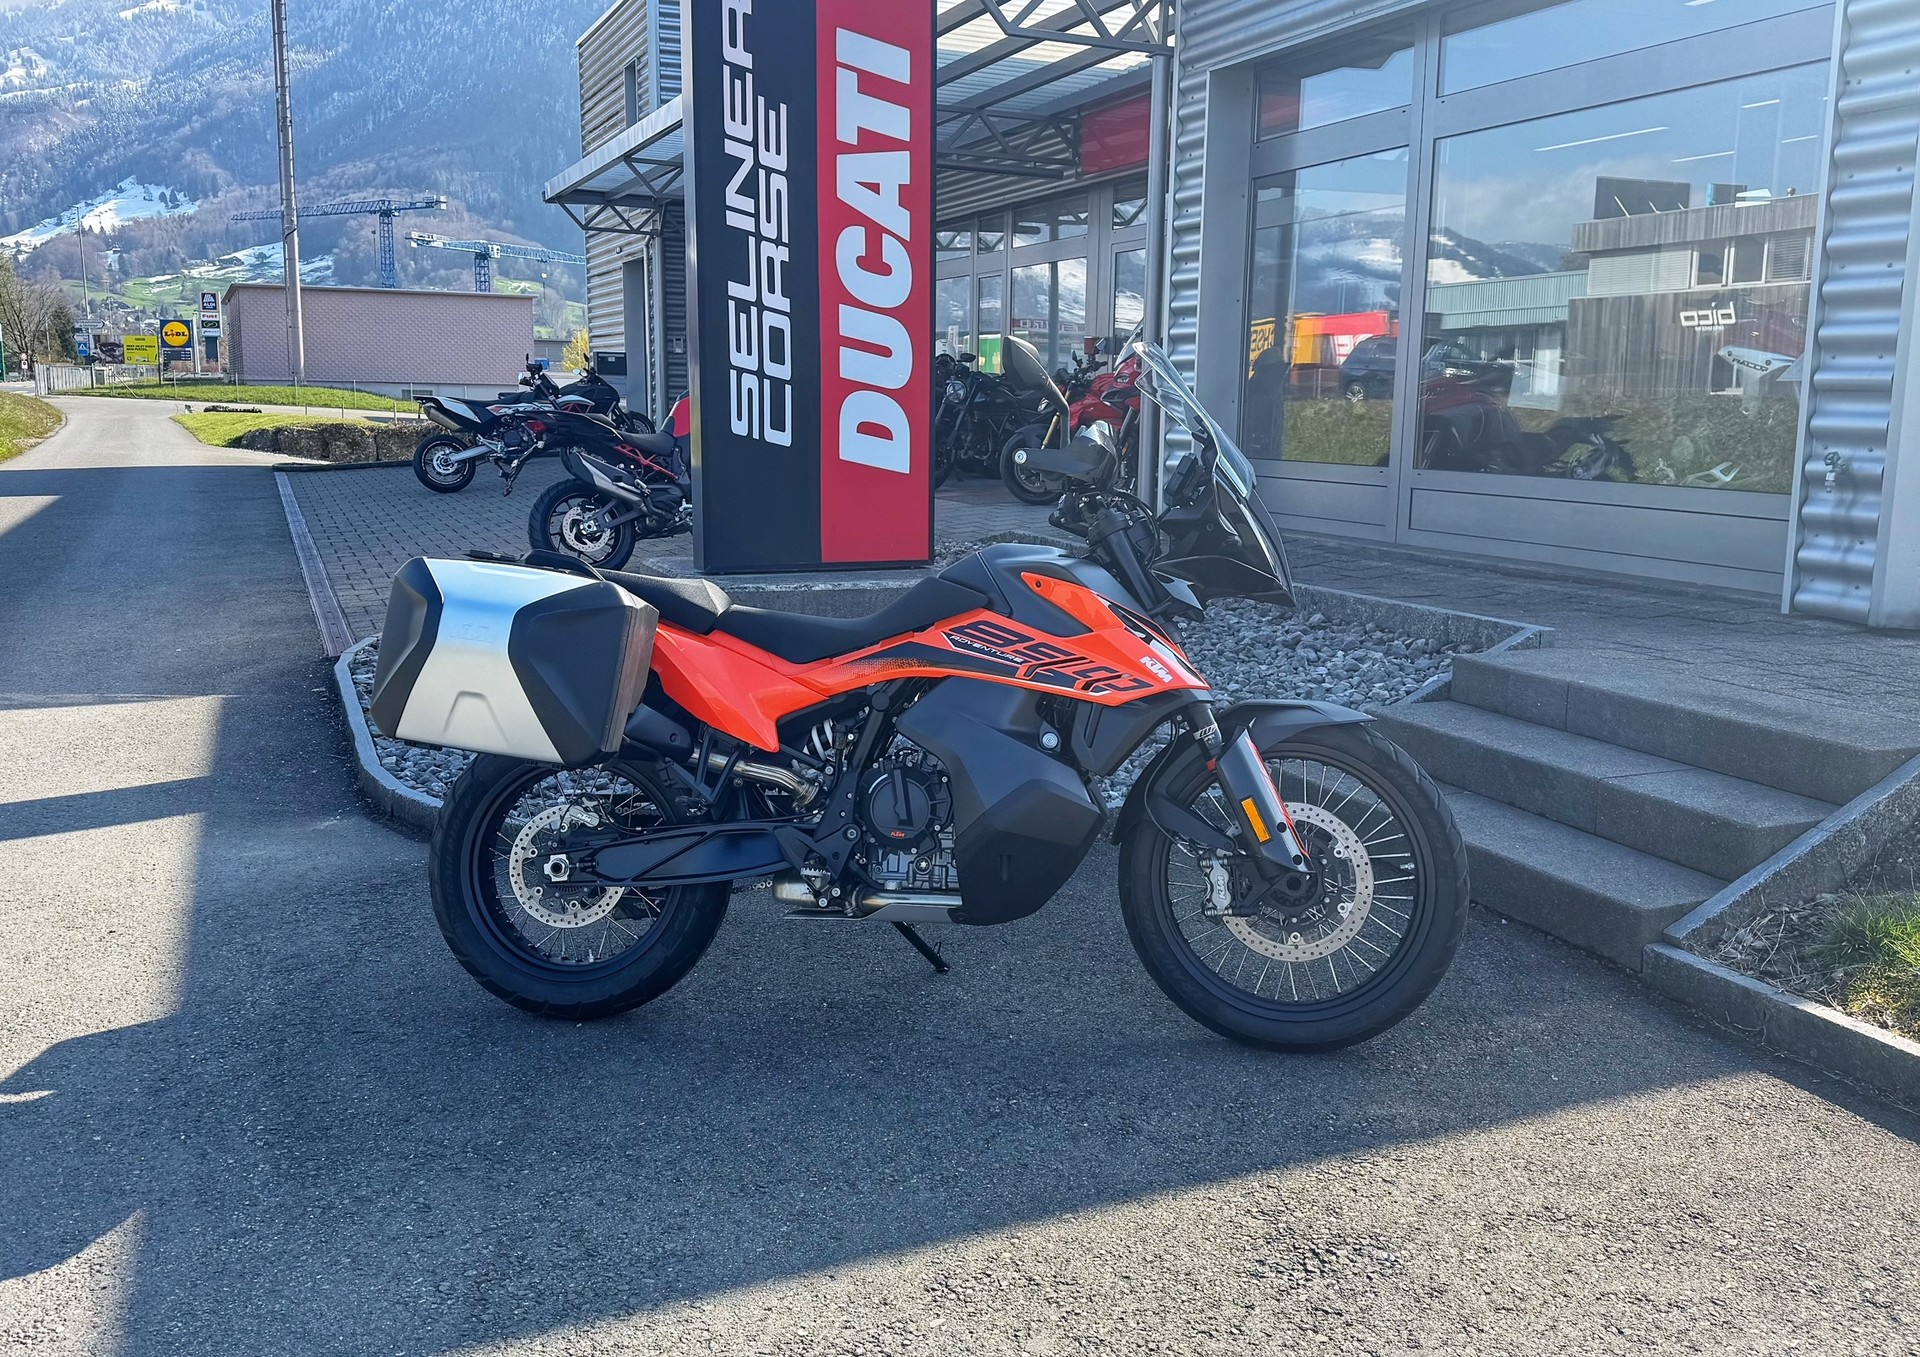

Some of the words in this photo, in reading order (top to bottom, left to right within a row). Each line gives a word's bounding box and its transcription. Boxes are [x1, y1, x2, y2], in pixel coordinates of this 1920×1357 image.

[722, 0, 760, 440] SELINER
[757, 95, 792, 447] CORSE
[835, 27, 913, 474] DUCATI
[949, 634, 1025, 663] ADVENTURE
[1139, 655, 1174, 683] KTM
